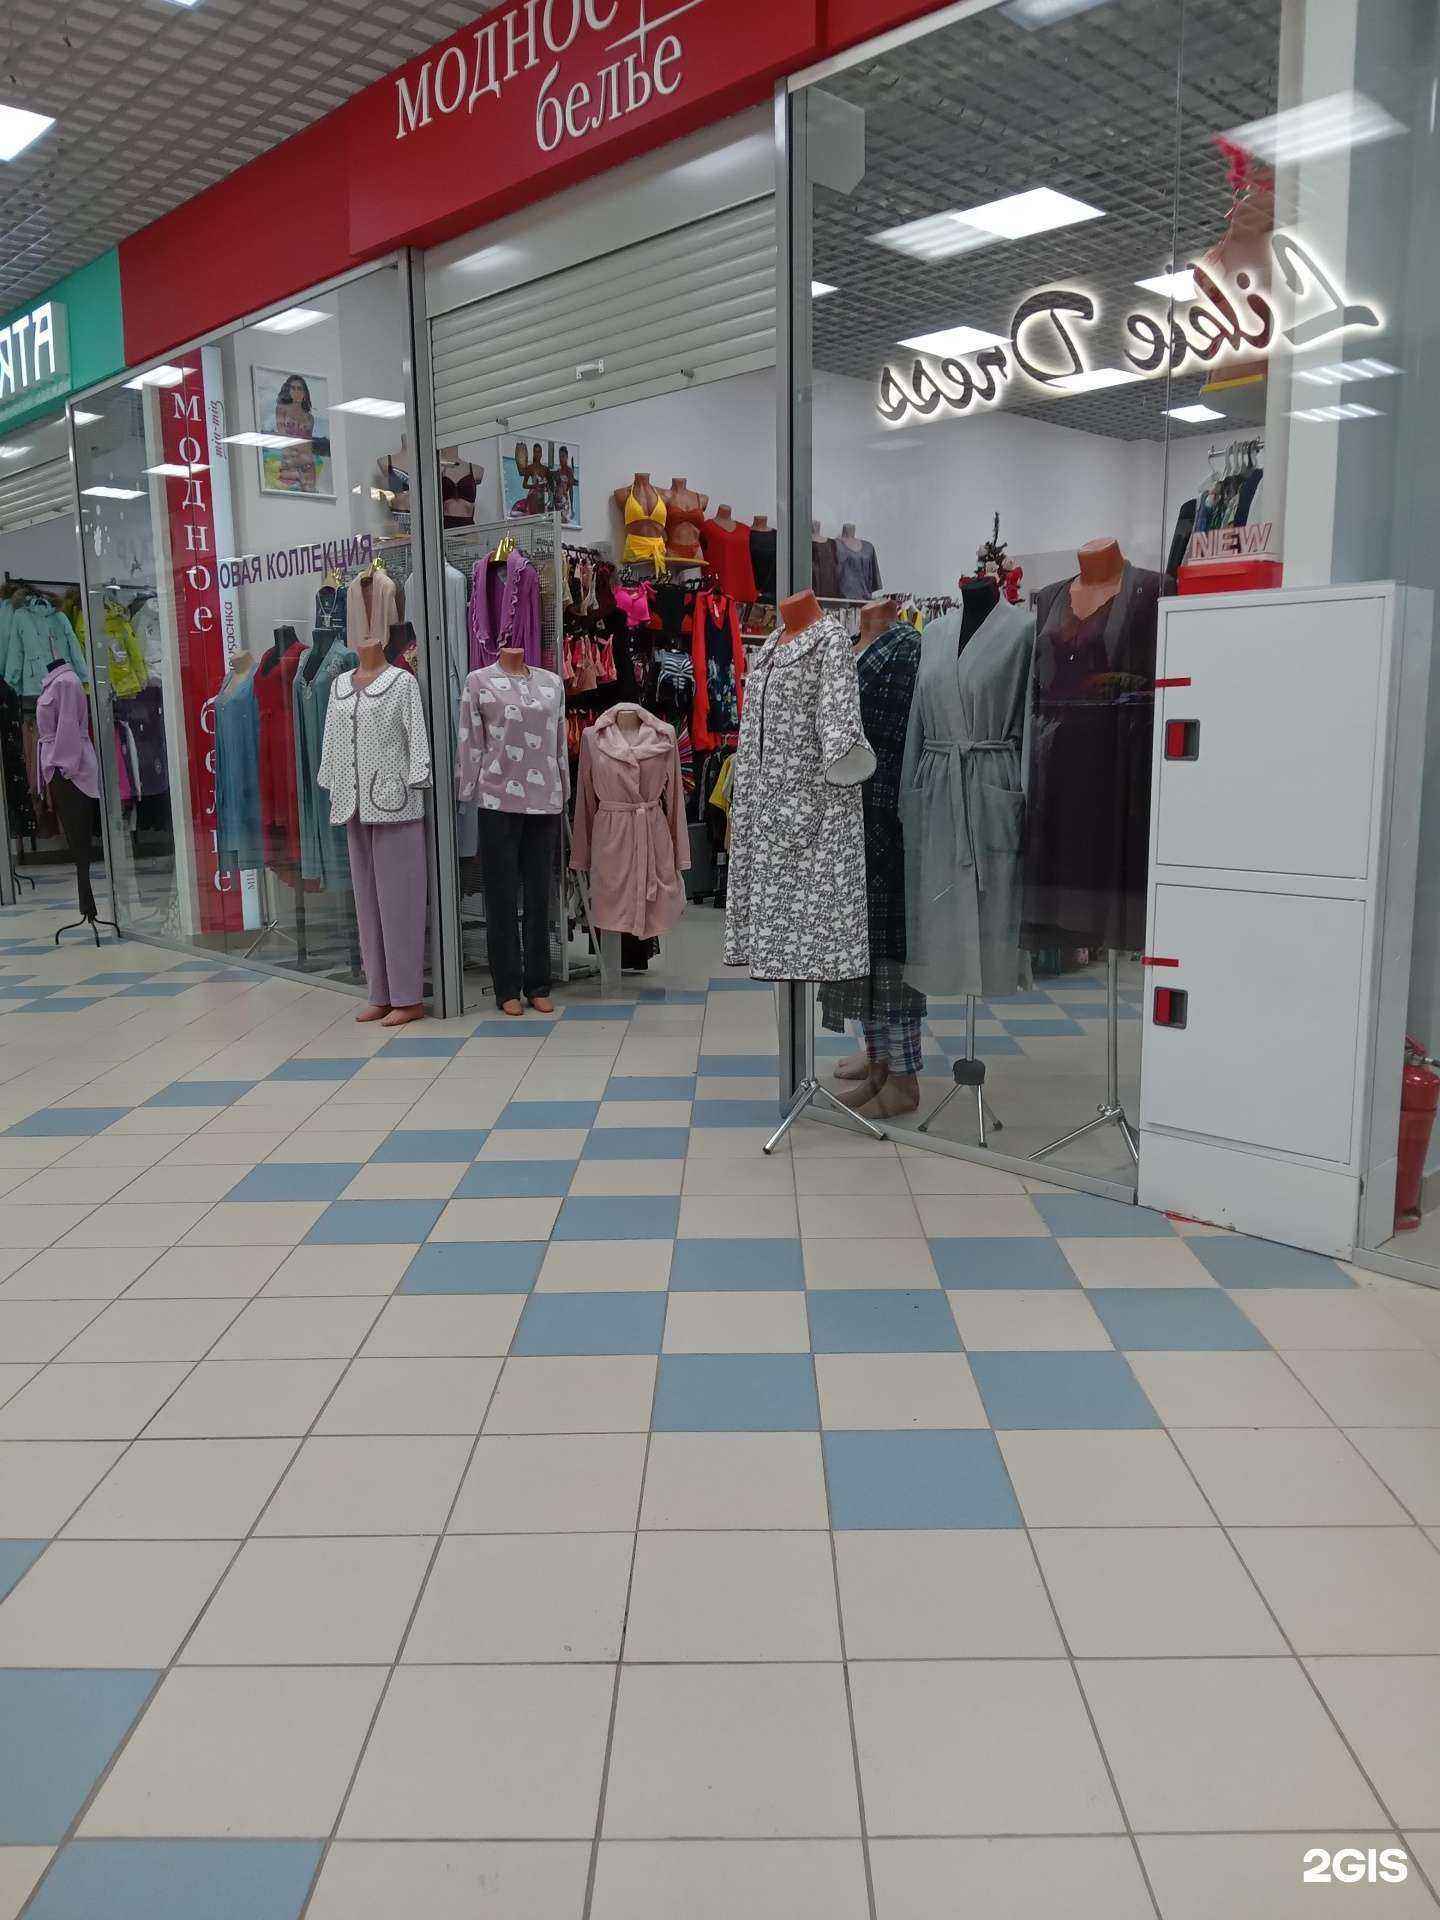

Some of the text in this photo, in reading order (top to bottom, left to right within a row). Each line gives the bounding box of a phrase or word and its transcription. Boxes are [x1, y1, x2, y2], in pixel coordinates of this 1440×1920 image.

[536, 35, 683, 151] белье
[219, 534, 374, 589] ОВАЯ КОЛЛЕКЦИЯ
[1190, 522, 1273, 560] NEW
